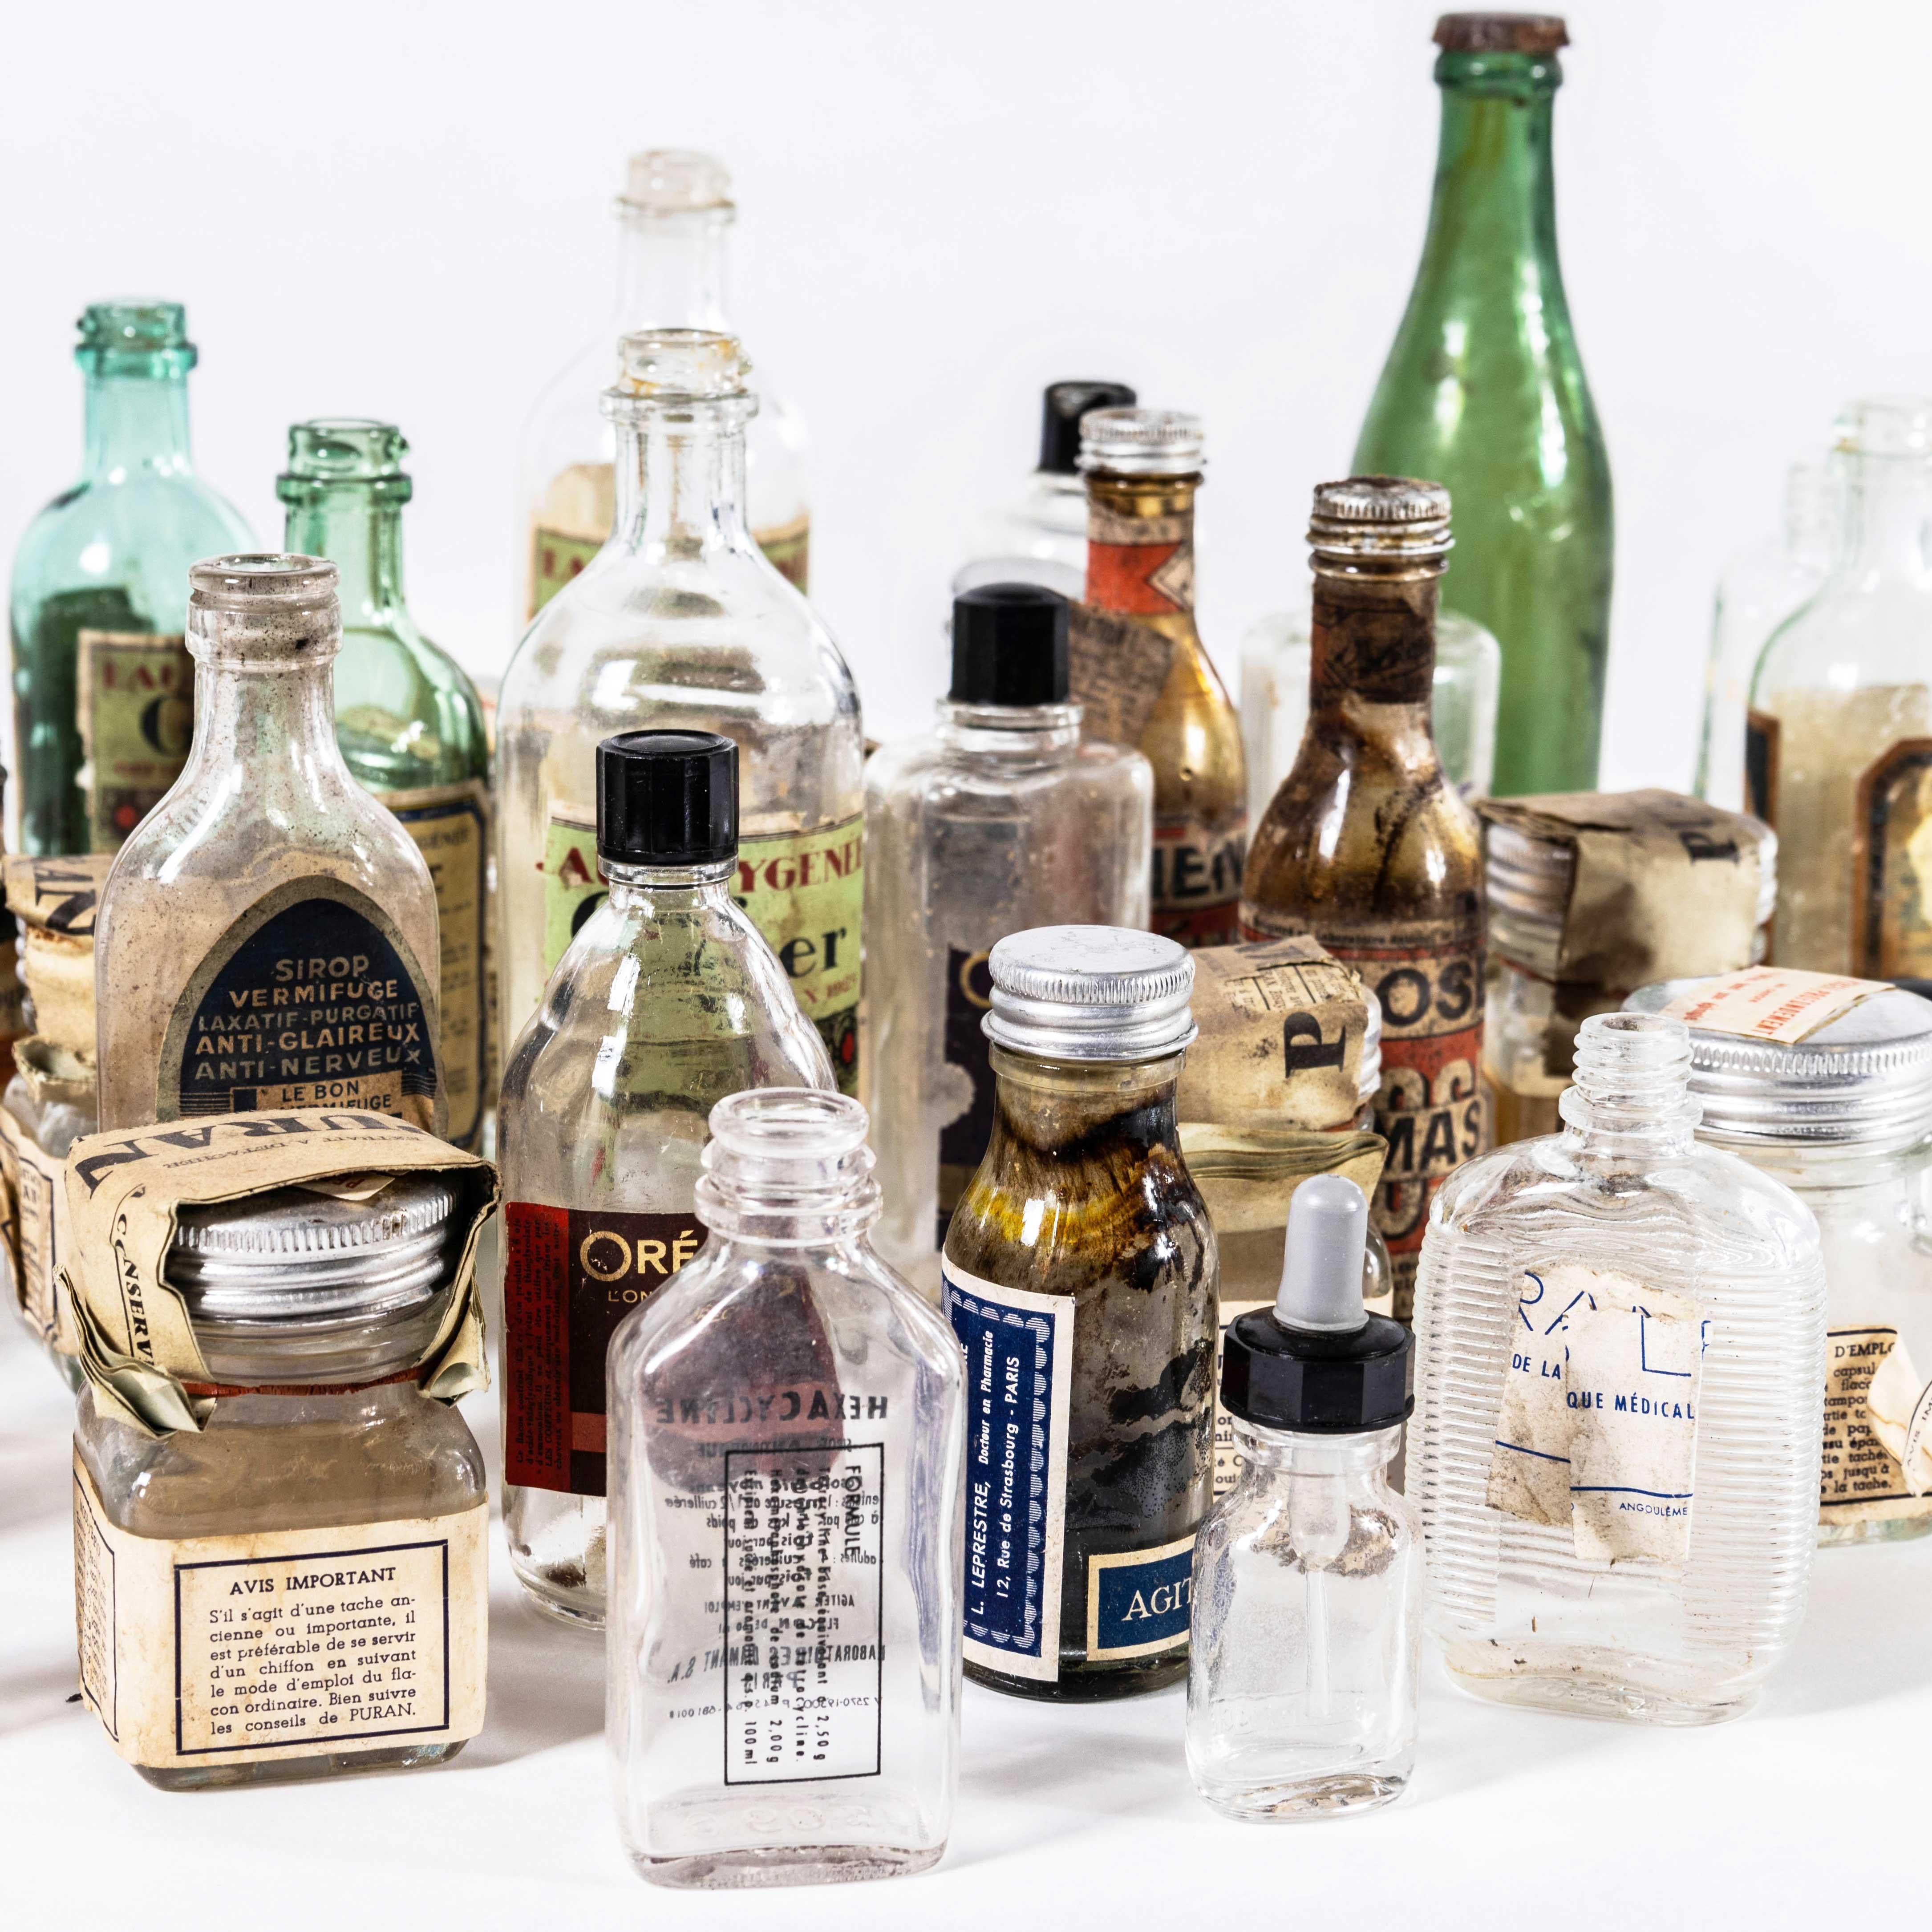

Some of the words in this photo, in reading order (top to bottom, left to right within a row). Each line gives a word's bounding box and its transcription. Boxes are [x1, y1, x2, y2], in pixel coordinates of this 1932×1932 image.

[275, 955, 369, 981] SIROP
[229, 980, 398, 1008] VERMIFUGE
[195, 1022, 420, 1055] ANTI-GLAIREUX
[194, 1049, 421, 1081] ANTI-NERVEUX
[282, 1087, 305, 1103] LE
[314, 1081, 359, 1100] BON
[534, 1220, 542, 1238] par
[535, 1244, 543, 1262] que
[513, 1260, 524, 1296] produit
[545, 1276, 553, 1300] pour
[524, 1291, 532, 1303] de
[980, 1330, 994, 1392] Pharmacie
[1512, 1353, 1531, 1372] DE
[1541, 1360, 1561, 1380] LA
[1833, 1363, 1877, 1381] capsul
[1005, 1356, 1021, 1405] PARIS
[544, 1384, 552, 1444] COIFFEURS
[555, 1412, 562, 1423] ou
[982, 1397, 992, 1415] en
[1567, 1391, 1603, 1409] QUE
[1614, 1392, 1695, 1419] MÉDICAL
[977, 1419, 991, 1466] Docteur
[544, 1448, 552, 1467] LES
[1001, 1423, 1020, 1508] Strasbourg
[1834, 1481, 1847, 1493] la
[1853, 1478, 1892, 1492] tache.
[844, 1465, 862, 1556] FORMULE
[1004, 1511, 1012, 1533] de
[971, 1482, 992, 1588] LEPRESTRE,
[998, 1538, 1011, 1568] Rue
[229, 1578, 275, 1596] AVIS
[286, 1567, 396, 1591] IMPORTANT
[996, 1569, 1011, 1598] 12,
[210, 1608, 233, 1624] S'il
[241, 1608, 284, 1625] s'agit
[290, 1603, 335, 1617] d'une
[340, 1596, 384, 1612] tache
[390, 1596, 416, 1607] an-
[970, 1596, 985, 1615] L.
[210, 1628, 263, 1643] cienne
[275, 1625, 295, 1637] ou
[306, 1615, 396, 1636] importante,
[405, 1611, 415, 1624] il
[770, 1627, 784, 1642] de
[210, 1648, 231, 1661] est
[237, 1640, 321, 1661] préférable
[326, 1637, 346, 1651] de
[351, 1636, 366, 1648] se
[372, 1630, 416, 1645] servir
[210, 1663, 246, 1680] d'un
[259, 1659, 314, 1675] chiffon
[327, 1657, 347, 1669] en
[357, 1650, 416, 1667] suivant
[210, 1684, 225, 1698] le
[234, 1680, 278, 1696] mode
[286, 1673, 355, 1693] d'emploi
[362, 1669, 383, 1684] du
[391, 1667, 416, 1681] fla-
[210, 1704, 239, 1717] con
[244, 1695, 322, 1714] ordinaire.
[328, 1690, 362, 1706] Bien
[368, 1687, 416, 1704] suivre
[210, 1720, 232, 1735] les
[244, 1715, 306, 1732] conseils
[318, 1711, 338, 1725] de
[349, 1702, 416, 1721] PURAN.
[744, 1721, 757, 1744] 100
[814, 1715, 830, 1747] 2,50
[768, 1720, 782, 1751] 2,00
[744, 1749, 758, 1765] ml
